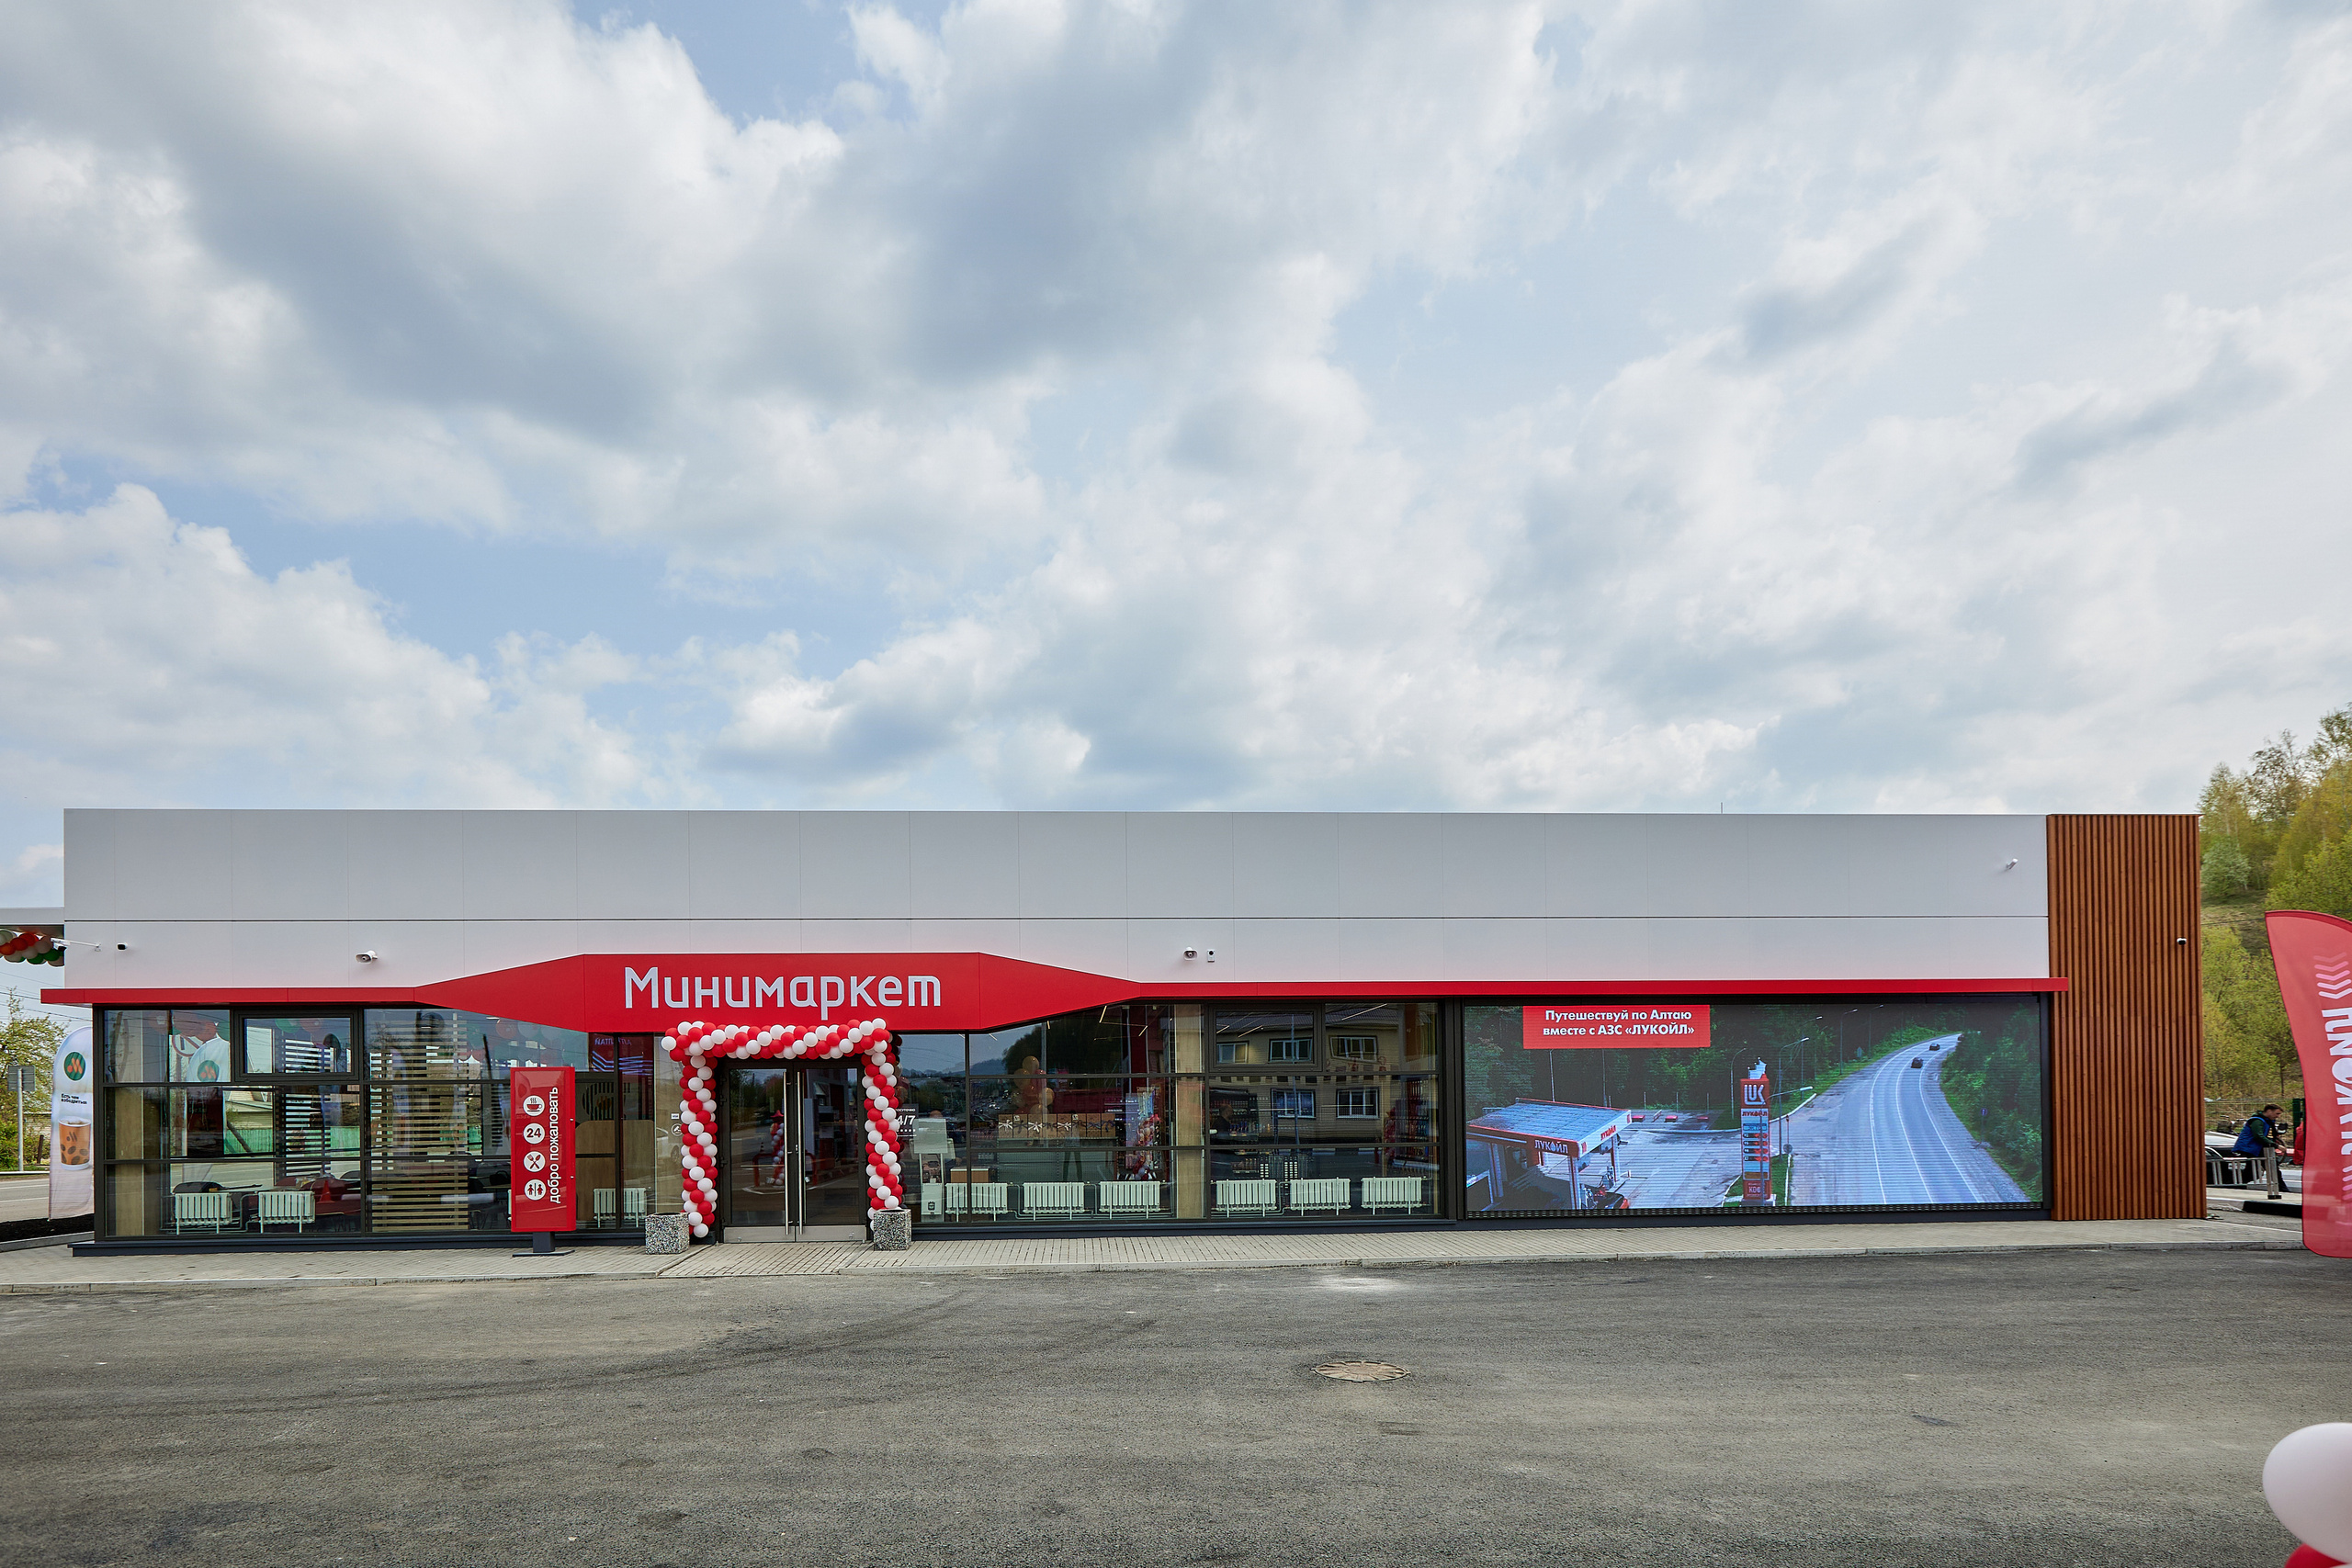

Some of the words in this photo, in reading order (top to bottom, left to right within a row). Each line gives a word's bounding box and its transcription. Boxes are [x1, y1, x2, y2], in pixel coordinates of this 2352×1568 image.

[625, 966, 941, 1021] Минимаркет
[1545, 1010, 1629, 1022] Путешествуй
[1632, 1012, 1647, 1021] по
[1649, 1010, 1692, 1021] Алтаю
[1543, 1027, 1587, 1035] вместе
[1589, 1027, 1595, 1035] с
[1597, 1024, 1623, 1035] АЗС
[1625, 1021, 1695, 1035] «ЛУКОЙЛ»
[548, 1087, 560, 1161] пожаловать
[897, 1115, 916, 1125] 4/7
[526, 1128, 542, 1138] 24
[548, 1163, 561, 1204] добро
